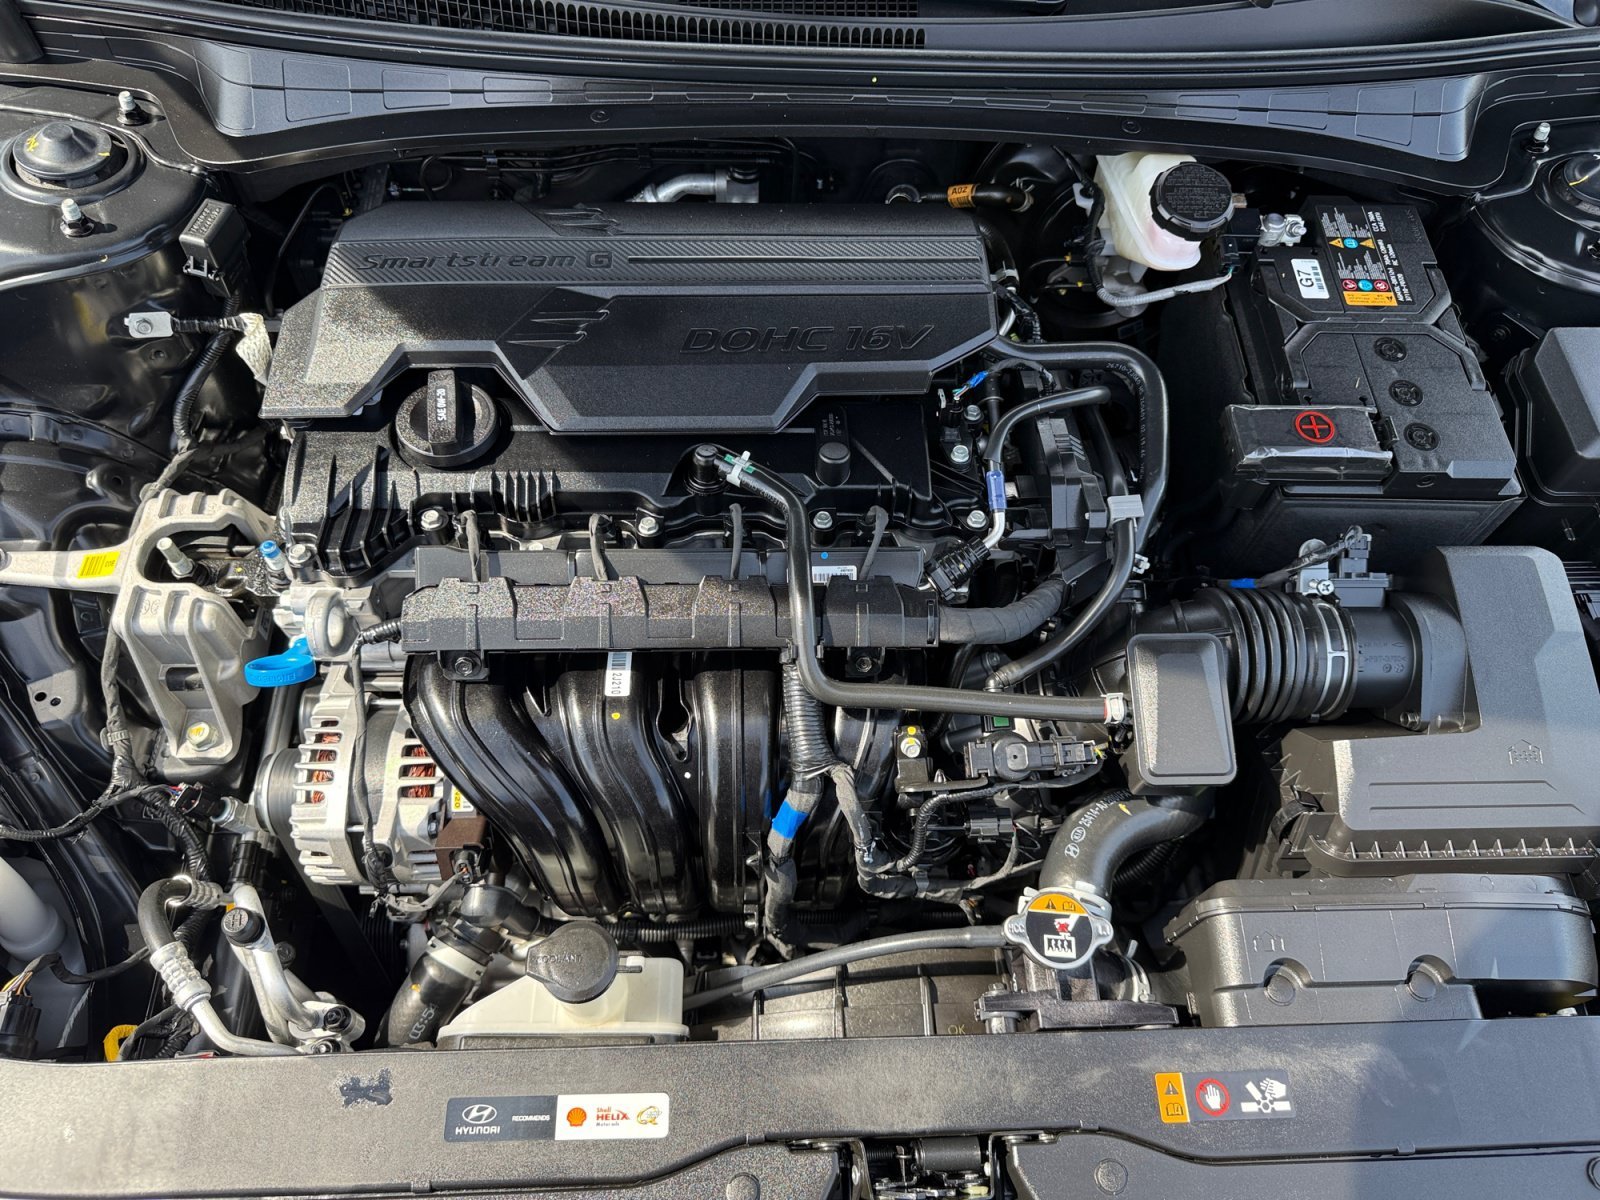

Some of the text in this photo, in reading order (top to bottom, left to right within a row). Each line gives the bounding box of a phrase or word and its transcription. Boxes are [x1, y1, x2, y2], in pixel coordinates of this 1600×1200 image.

[356, 251, 577, 271] Smartstream
[1299, 270, 1315, 288] G7
[680, 324, 935, 353] DOHC 16V
[436, 388, 447, 421] SAE 0W-20
[611, 672, 623, 695] 2J210
[947, 1024, 966, 1035] OK
[511, 1114, 550, 1122] RECOMMENDS
[596, 1110, 630, 1121] HELIX
[455, 1126, 501, 1135] HYUNDAI
